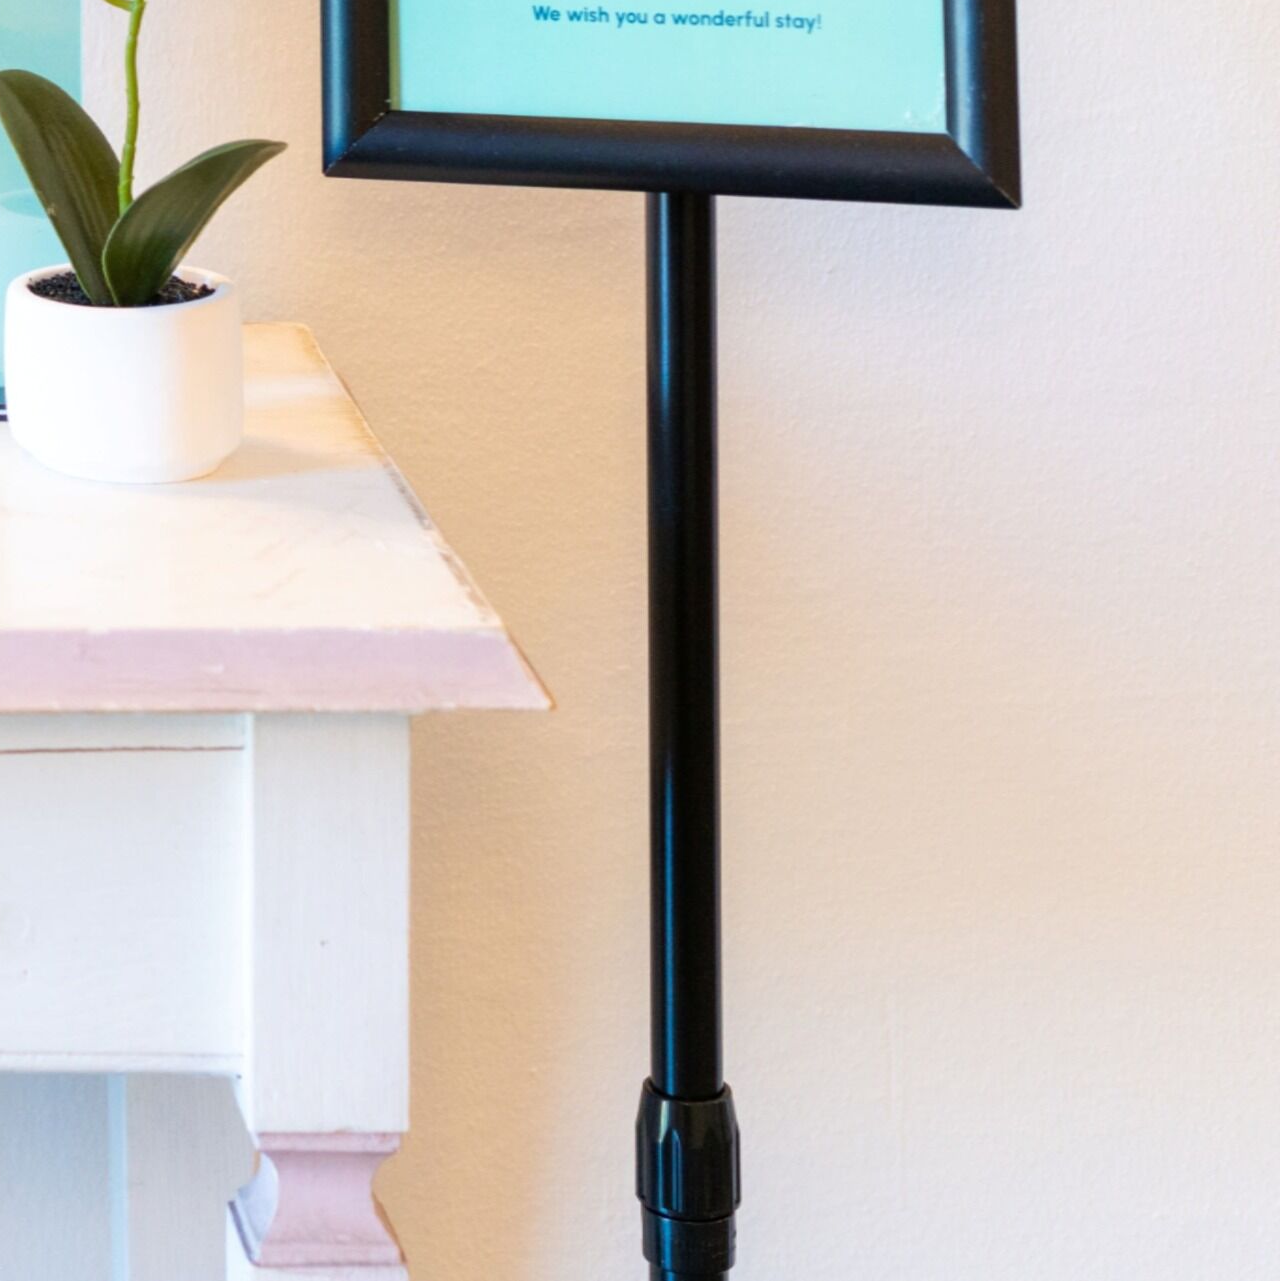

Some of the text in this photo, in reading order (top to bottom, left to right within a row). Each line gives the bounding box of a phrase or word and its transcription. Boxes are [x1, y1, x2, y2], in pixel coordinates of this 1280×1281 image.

[532, 5, 822, 34] We wish you a wonderful stay!
